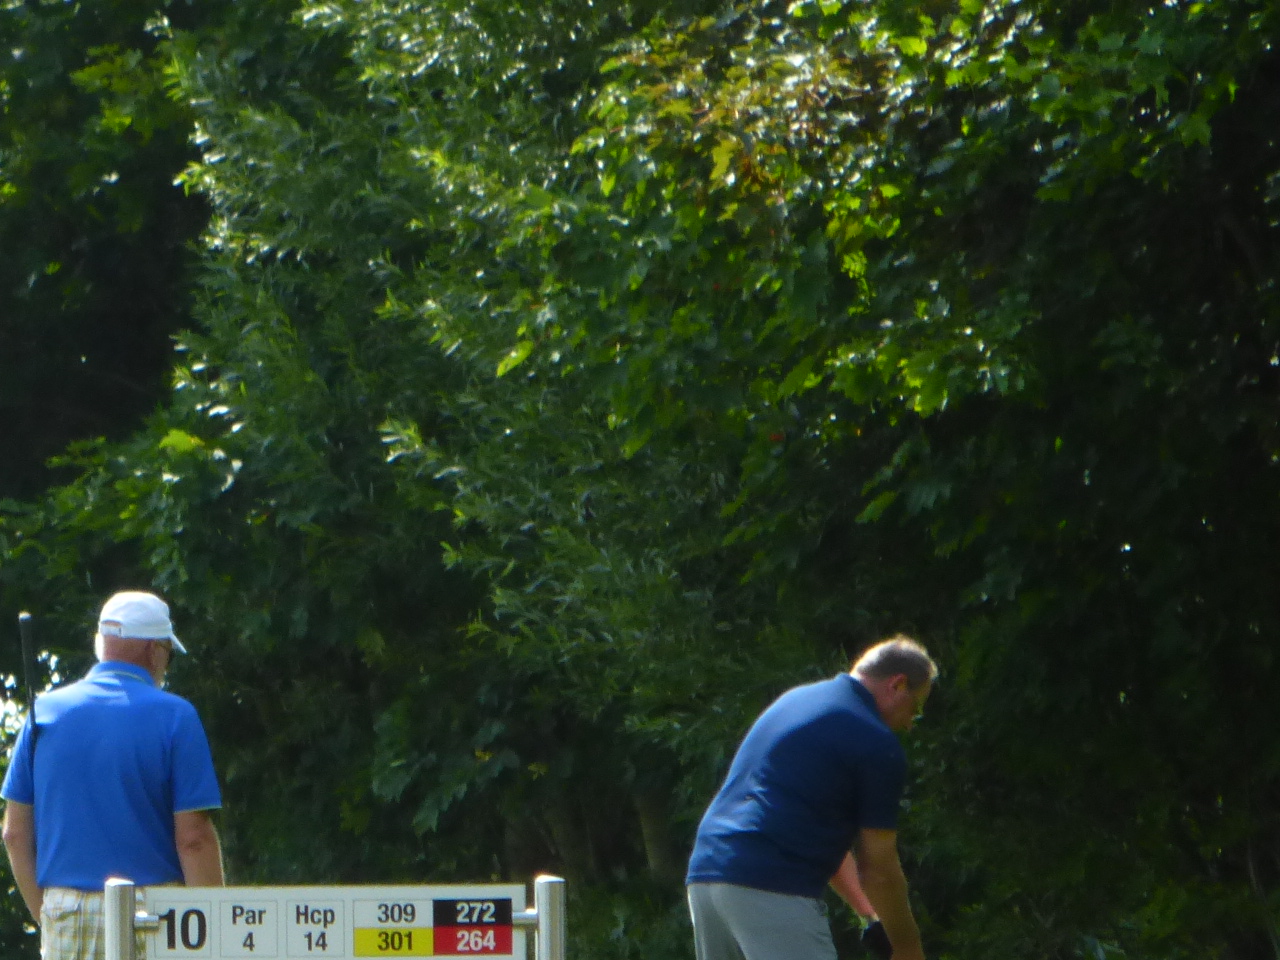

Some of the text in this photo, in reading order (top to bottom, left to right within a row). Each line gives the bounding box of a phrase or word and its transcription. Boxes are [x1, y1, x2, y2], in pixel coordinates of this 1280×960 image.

[231, 904, 267, 926] Par
[295, 904, 336, 929] Hcp
[377, 903, 416, 924] 309
[456, 902, 496, 924] 272
[159, 908, 207, 951] 10
[242, 931, 256, 951] 4
[304, 931, 328, 952] 14
[377, 931, 414, 951] 301
[456, 930, 497, 951] 264
